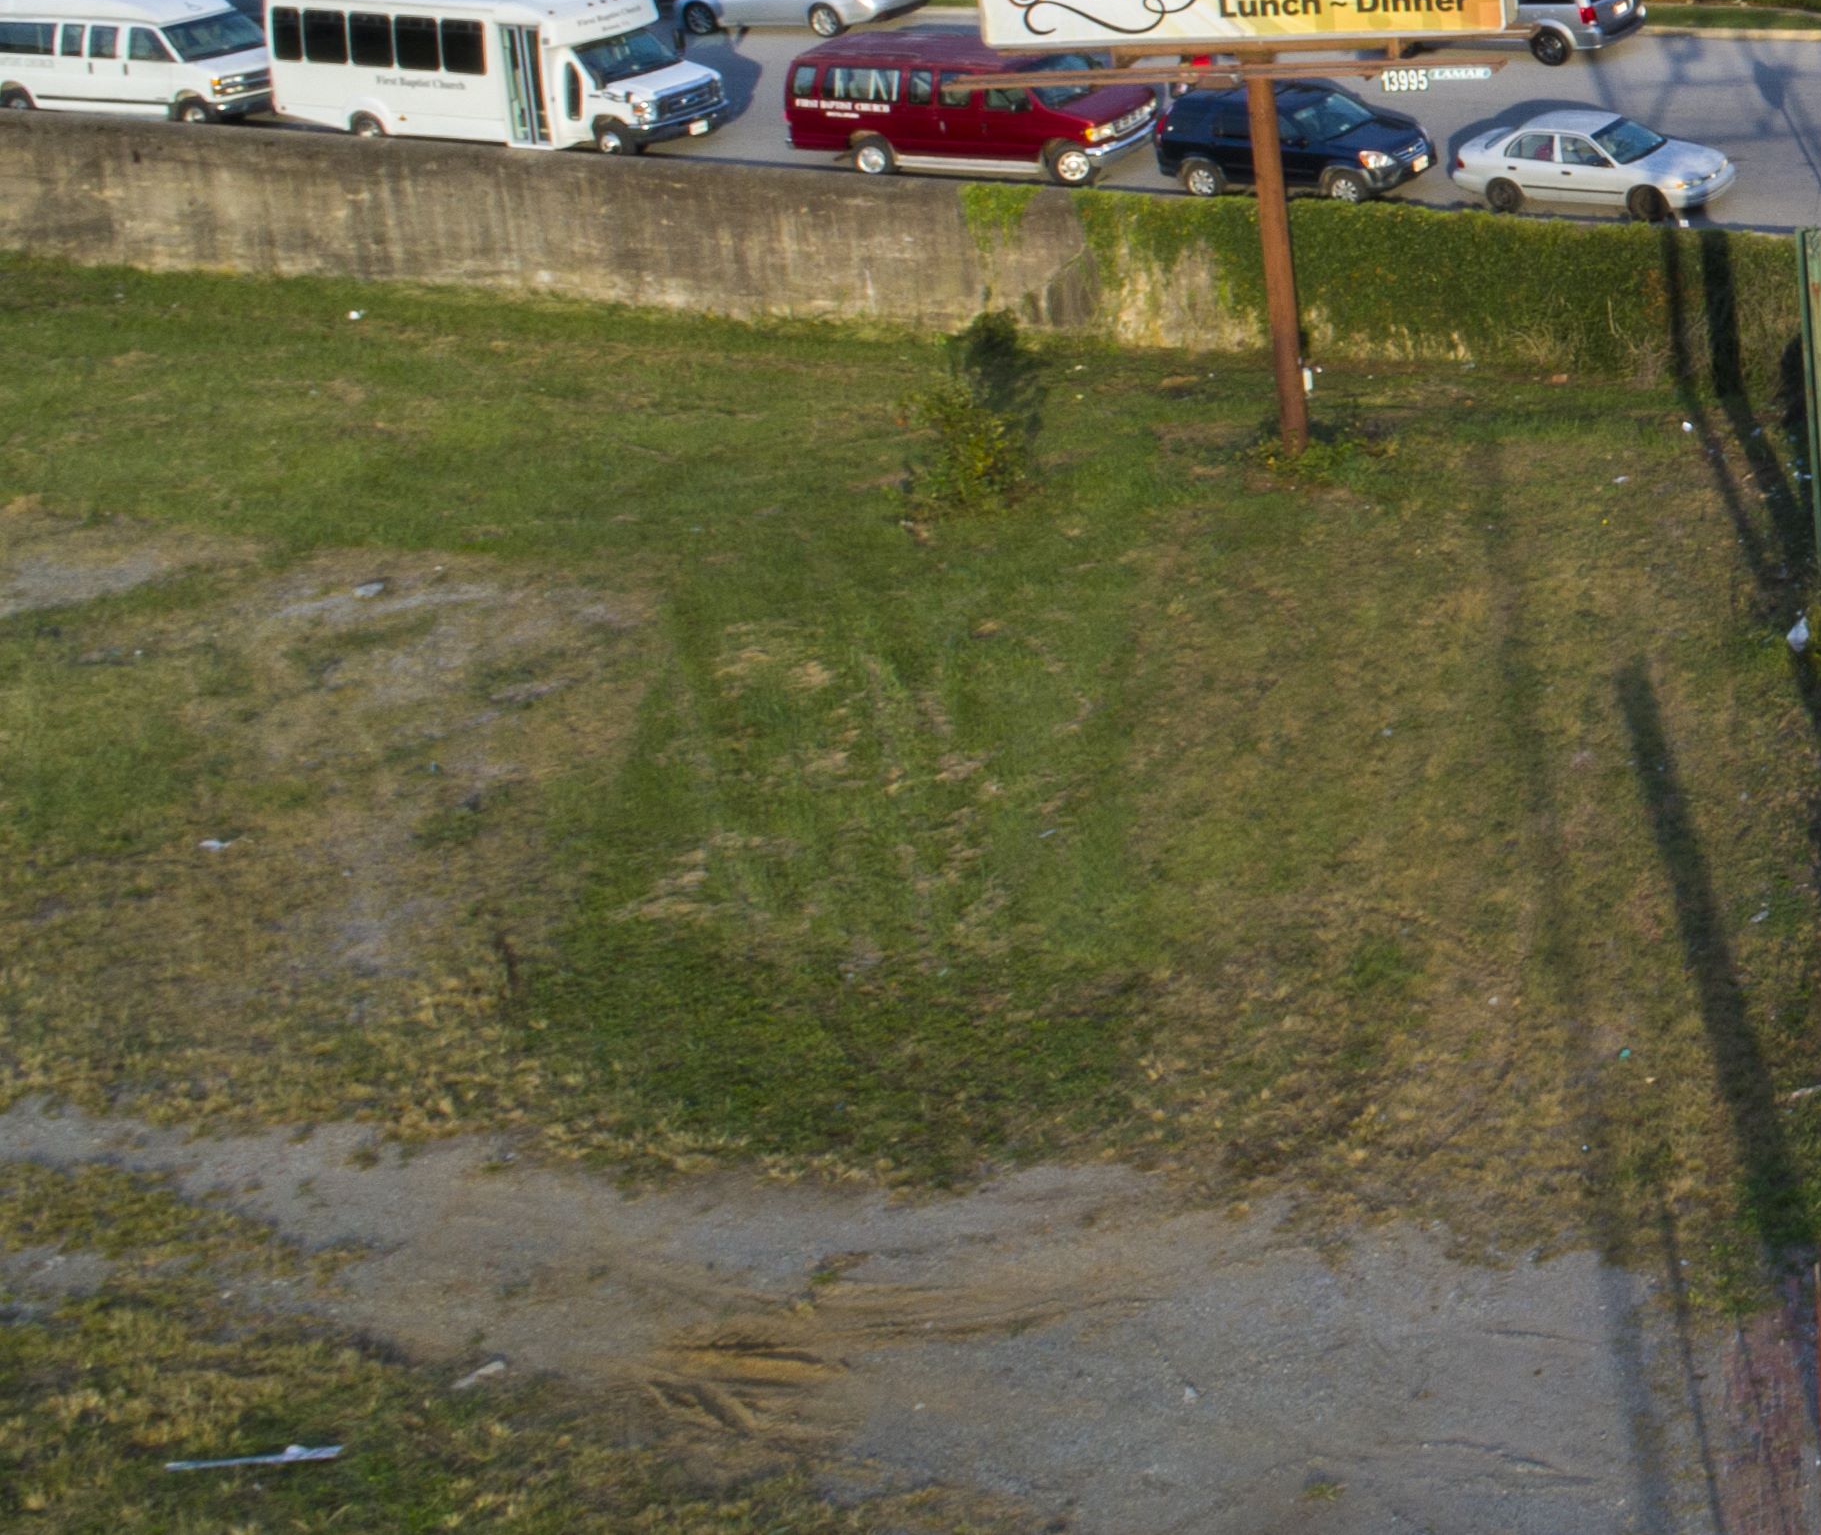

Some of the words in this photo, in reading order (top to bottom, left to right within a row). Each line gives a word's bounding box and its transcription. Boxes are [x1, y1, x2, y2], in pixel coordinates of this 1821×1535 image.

[376, 74, 397, 85] First
[432, 78, 466, 90] Church
[1381, 69, 1428, 92] 13995
